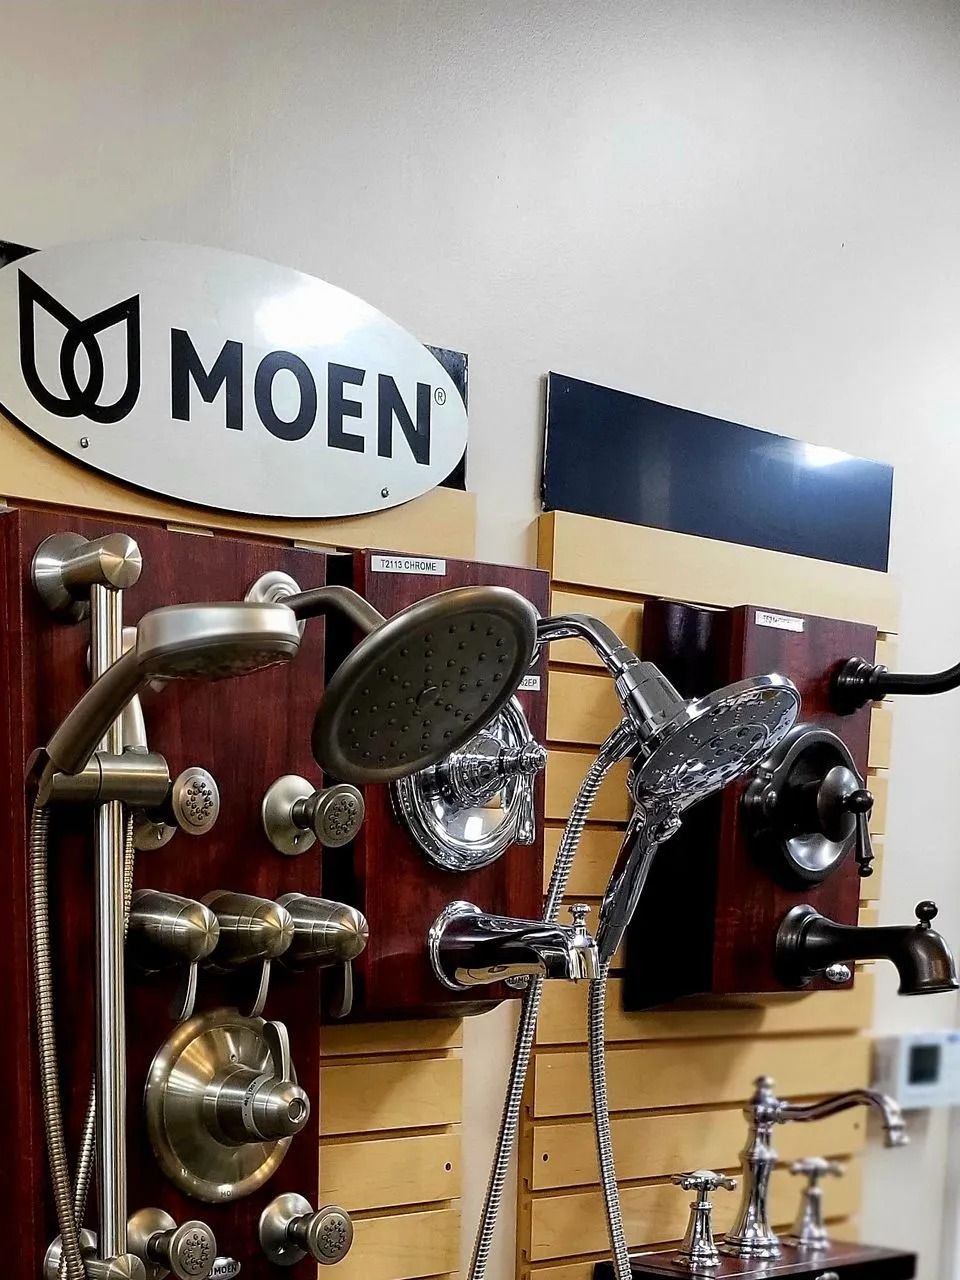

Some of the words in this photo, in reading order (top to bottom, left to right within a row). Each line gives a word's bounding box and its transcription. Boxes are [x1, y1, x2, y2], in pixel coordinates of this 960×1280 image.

[171, 327, 431, 465] MOEN
[381, 559, 402, 569] T2113
[404, 560, 437, 571] CHROME
[213, 1262, 237, 1276] MOEN
